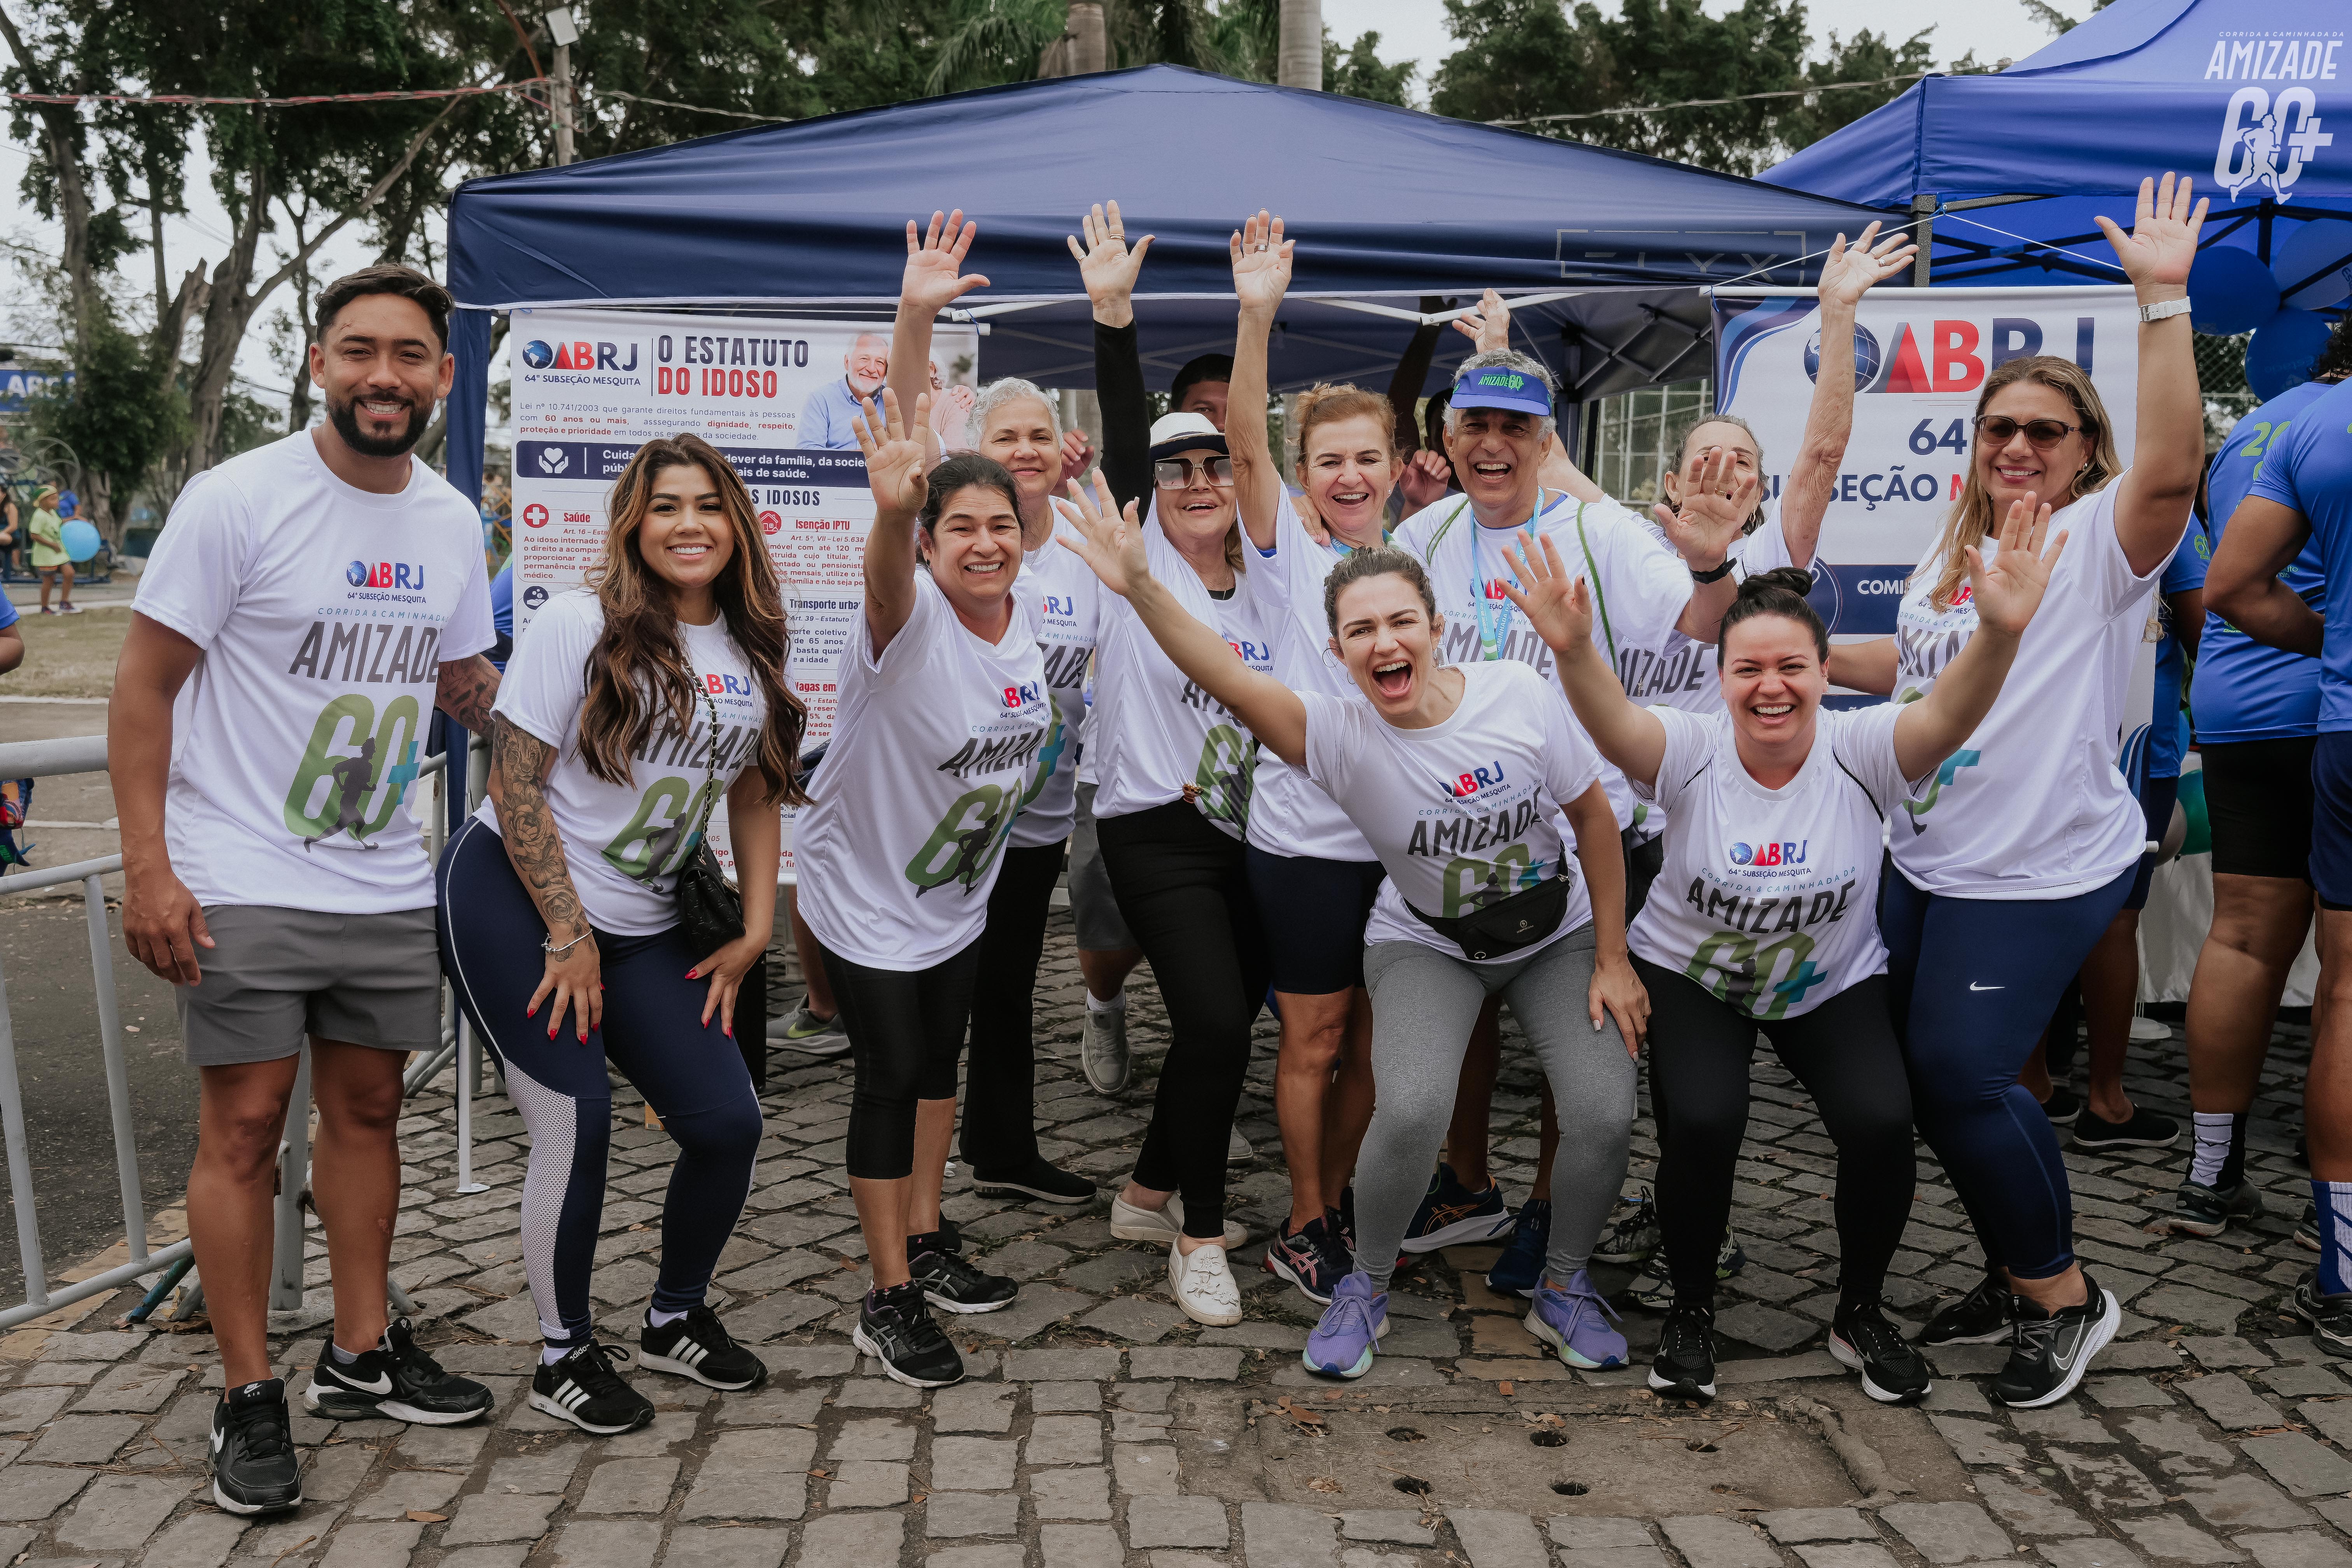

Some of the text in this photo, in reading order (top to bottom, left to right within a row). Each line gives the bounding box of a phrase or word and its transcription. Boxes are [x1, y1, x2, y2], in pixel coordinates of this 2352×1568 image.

[658, 335, 809, 368] O ESTATUTO
[542, 374, 590, 385] SUBSEÇÃO
[593, 376, 641, 386] MESQUITA
[658, 367, 777, 398] DO IDOSO
[1478, 375, 1508, 387] AMIZADE
[549, 403, 599, 412] 10.741/2003
[621, 406, 653, 415] garante
[691, 408, 746, 417] fundamentais
[607, 417, 629, 425] mais,
[707, 420, 751, 430] dignidade,
[758, 422, 796, 431] respeito,
[520, 426, 559, 434] proteção
[568, 427, 612, 435] prioridade
[759, 455, 772, 464] da
[775, 455, 815, 467] família,
[818, 457, 833, 466] da
[756, 467, 810, 478] de saúde.
[767, 489, 821, 507] IDOSOS
[563, 512, 850, 532] Saúde Isenção IPTU
[359, 592, 389, 602] SUBSEÇÃO
[391, 595, 427, 604] MESQUITA
[790, 598, 836, 610] Transporte
[318, 607, 368, 617] CORRIDA
[1444, 610, 1477, 620] CORRID
[1900, 611, 1931, 625] ORRIDA
[1047, 618, 1077, 627] MESQUITA
[724, 699, 753, 708] MESQUITA
[971, 724, 1015, 733] CORRIDA
[1480, 783, 1511, 799] MESQUITA
[1477, 785, 1532, 813] CAMINHADA
[1701, 867, 1752, 892] CORRIDA
[1767, 875, 1840, 892] CAMINHADA
[1844, 866, 1855, 877] DA
[1742, 869, 1777, 879] SUBSEÇÃO
[1778, 868, 1812, 878] MESQUITA
[1686, 876, 1855, 933] AMIZADE
